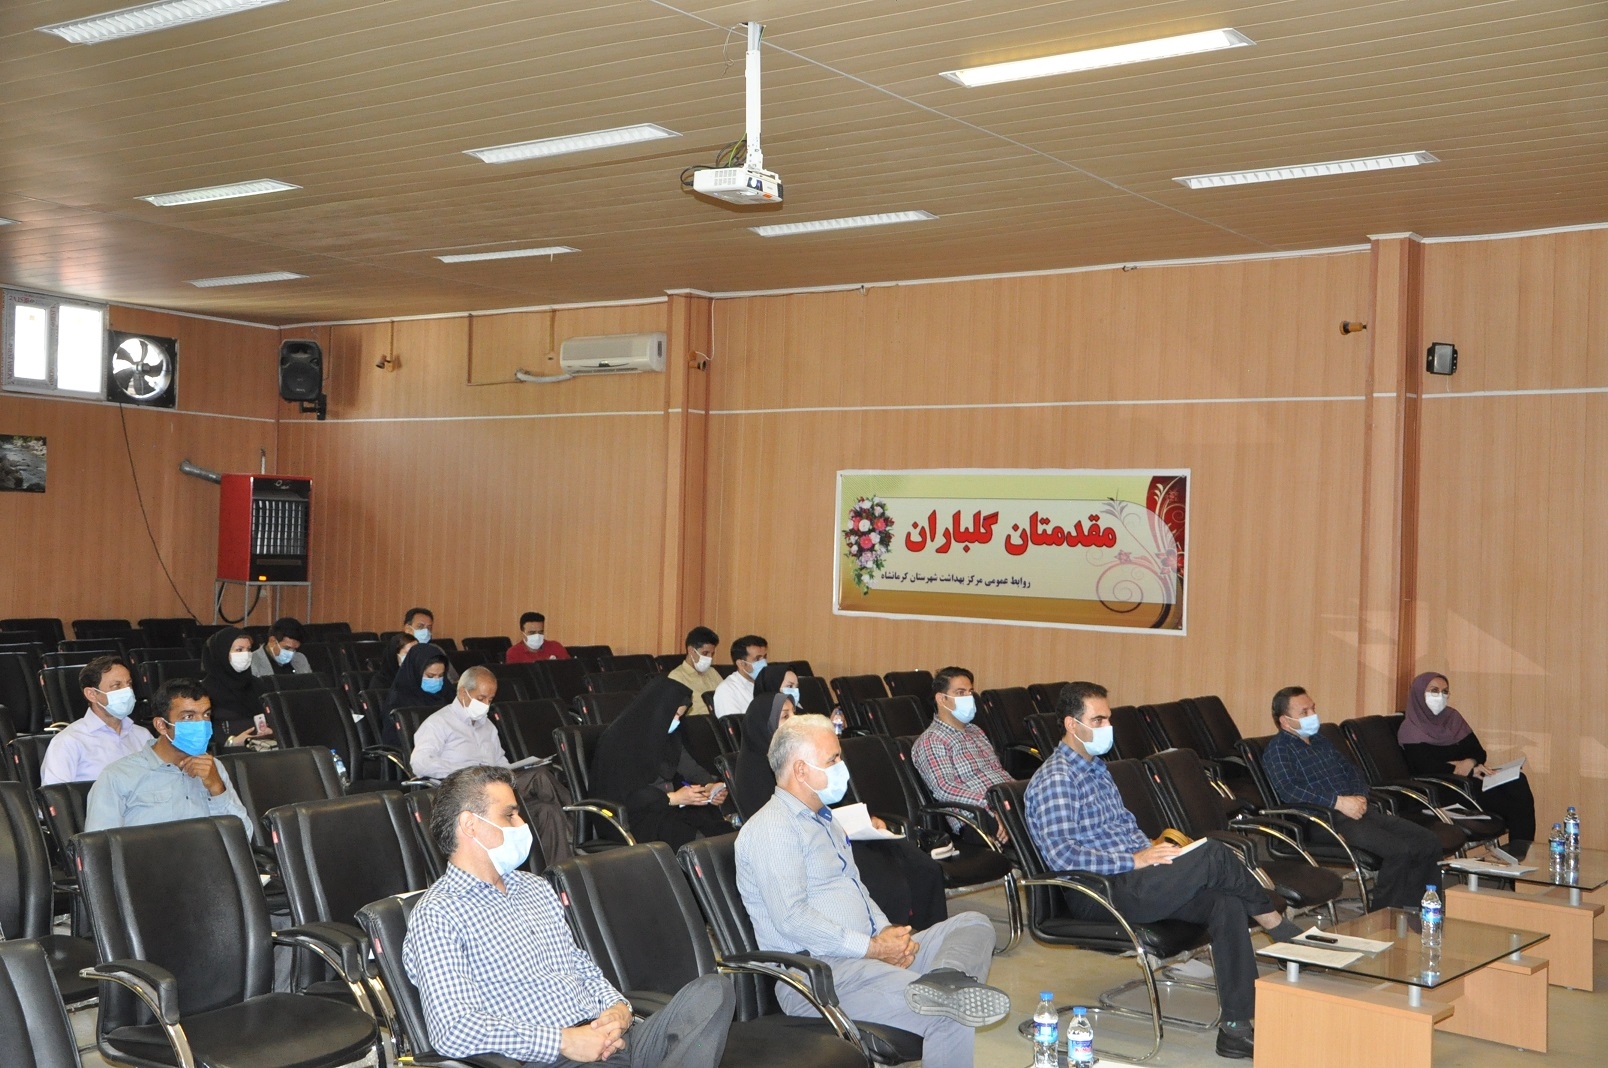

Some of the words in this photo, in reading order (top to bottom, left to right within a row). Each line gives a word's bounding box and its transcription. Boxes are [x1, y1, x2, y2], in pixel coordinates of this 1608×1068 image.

[904, 510, 999, 554] گلباران
[1004, 511, 1117, 556] مقدمتان
[880, 571, 909, 583] کرمانشاه
[909, 572, 937, 584] شهرستان
[939, 573, 965, 586] بهداشت
[966, 574, 983, 586] مرکز
[984, 577, 1009, 587] عمومی
[1010, 575, 1031, 588] روابط
